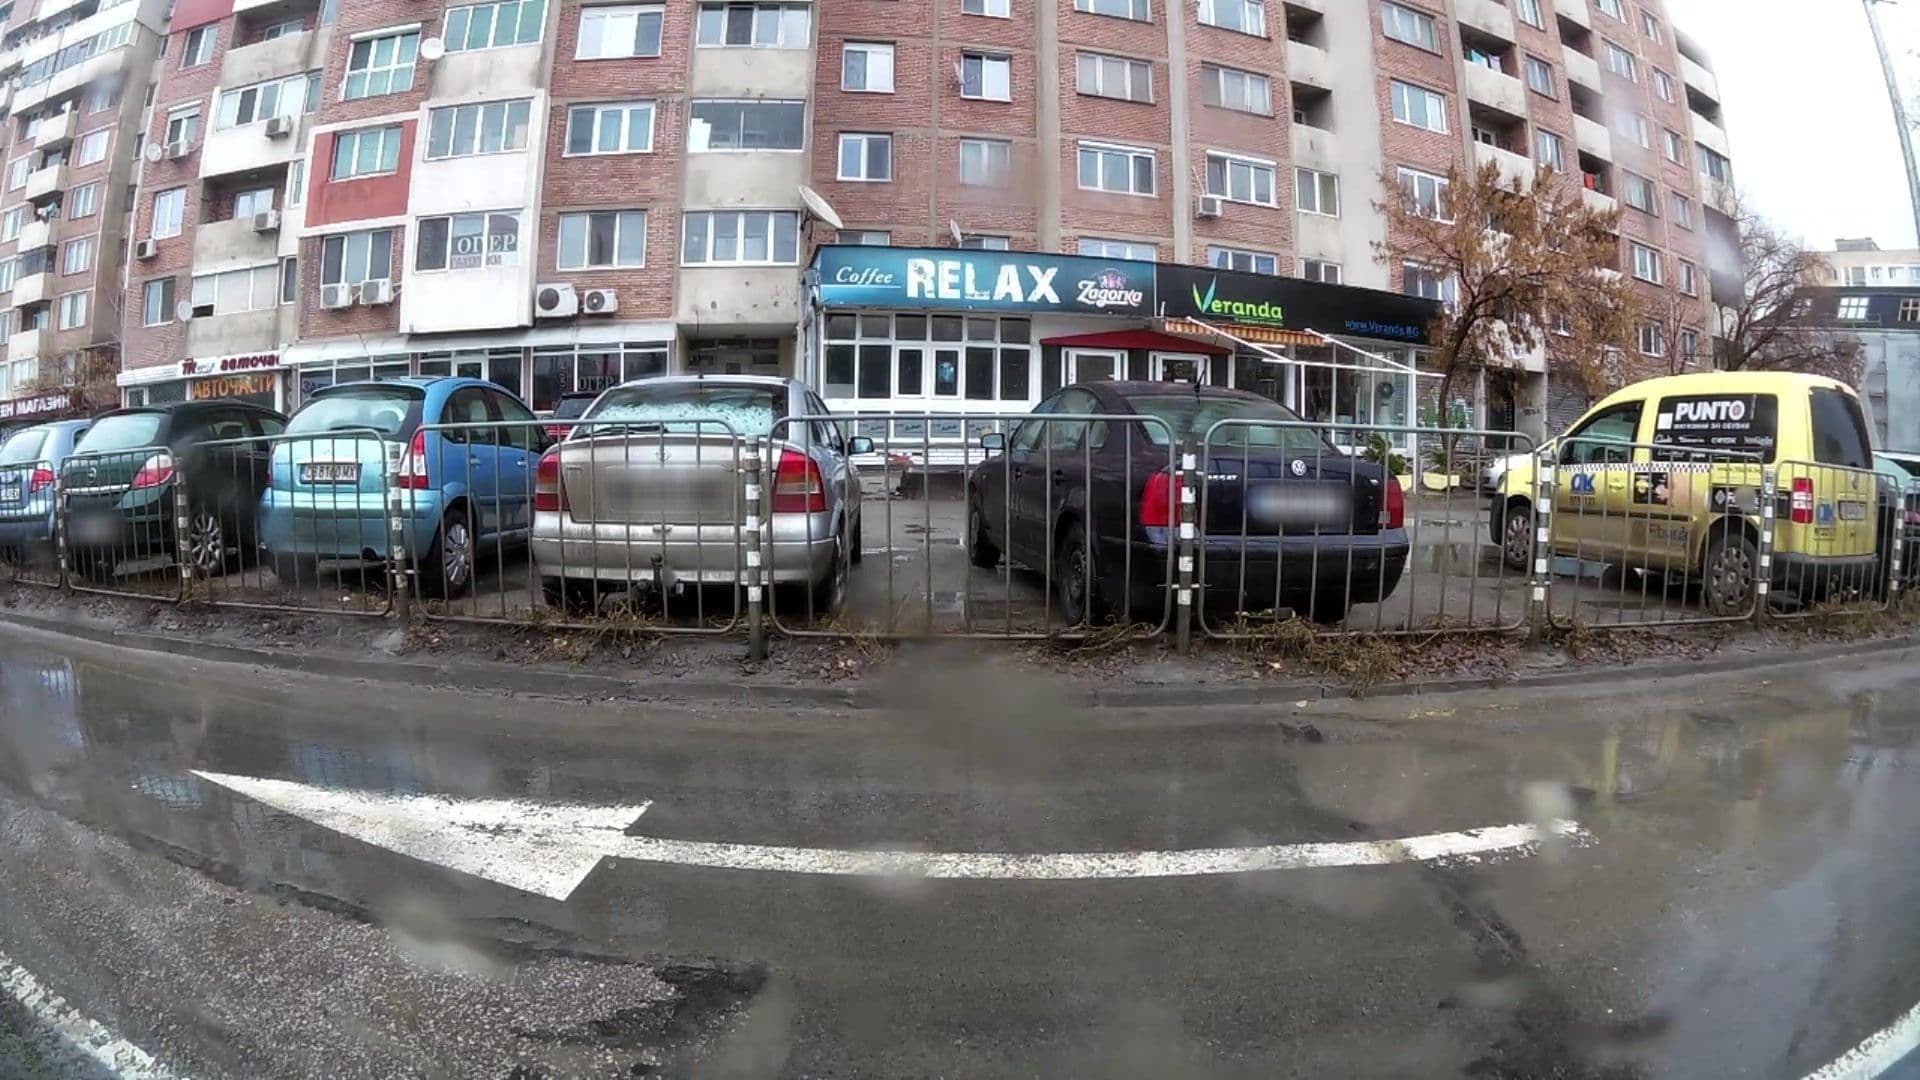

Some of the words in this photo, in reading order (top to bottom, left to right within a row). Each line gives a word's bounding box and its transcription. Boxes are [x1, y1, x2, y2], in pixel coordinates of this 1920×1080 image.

[836, 266, 893, 284] Coffee
[907, 258, 1060, 303] RELAX
[1076, 280, 1143, 307] Zagorka
[1193, 273, 1283, 320] Veranda
[192, 373, 276, 398] АВТОЧАСТИ
[16, 395, 70, 415] МАГАЗИН
[1675, 400, 1745, 421] PUNTO
